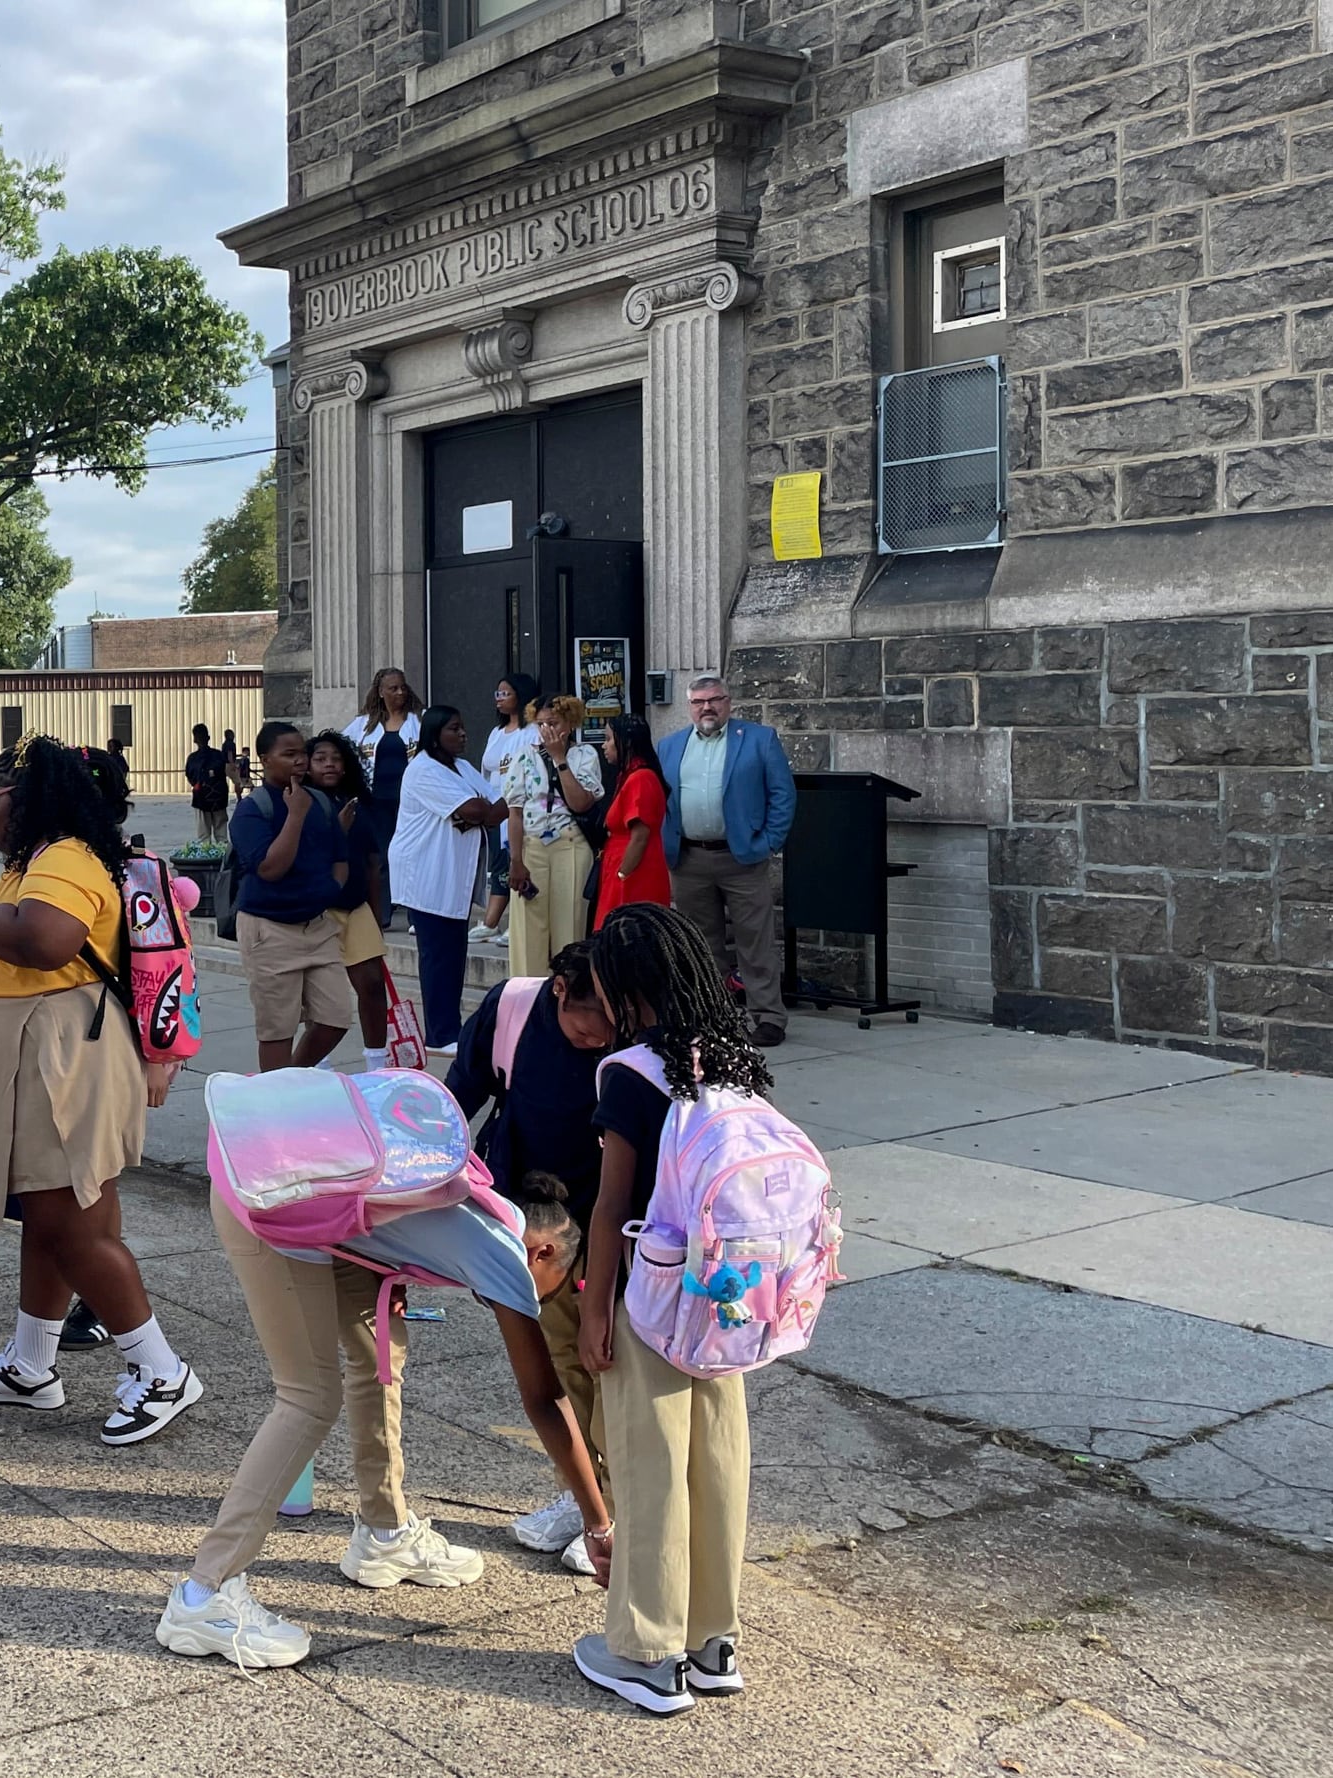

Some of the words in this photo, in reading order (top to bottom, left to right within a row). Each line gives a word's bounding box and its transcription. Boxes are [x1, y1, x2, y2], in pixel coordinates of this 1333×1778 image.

[305, 289, 323, 329] 19
[326, 247, 450, 322] OVERBROOK
[457, 218, 542, 285] PUBLIC
[553, 179, 664, 254] SCHOOL
[669, 162, 710, 218] 06
[587, 660, 614, 677] BACK
[589, 671, 623, 692] SCHOOL
